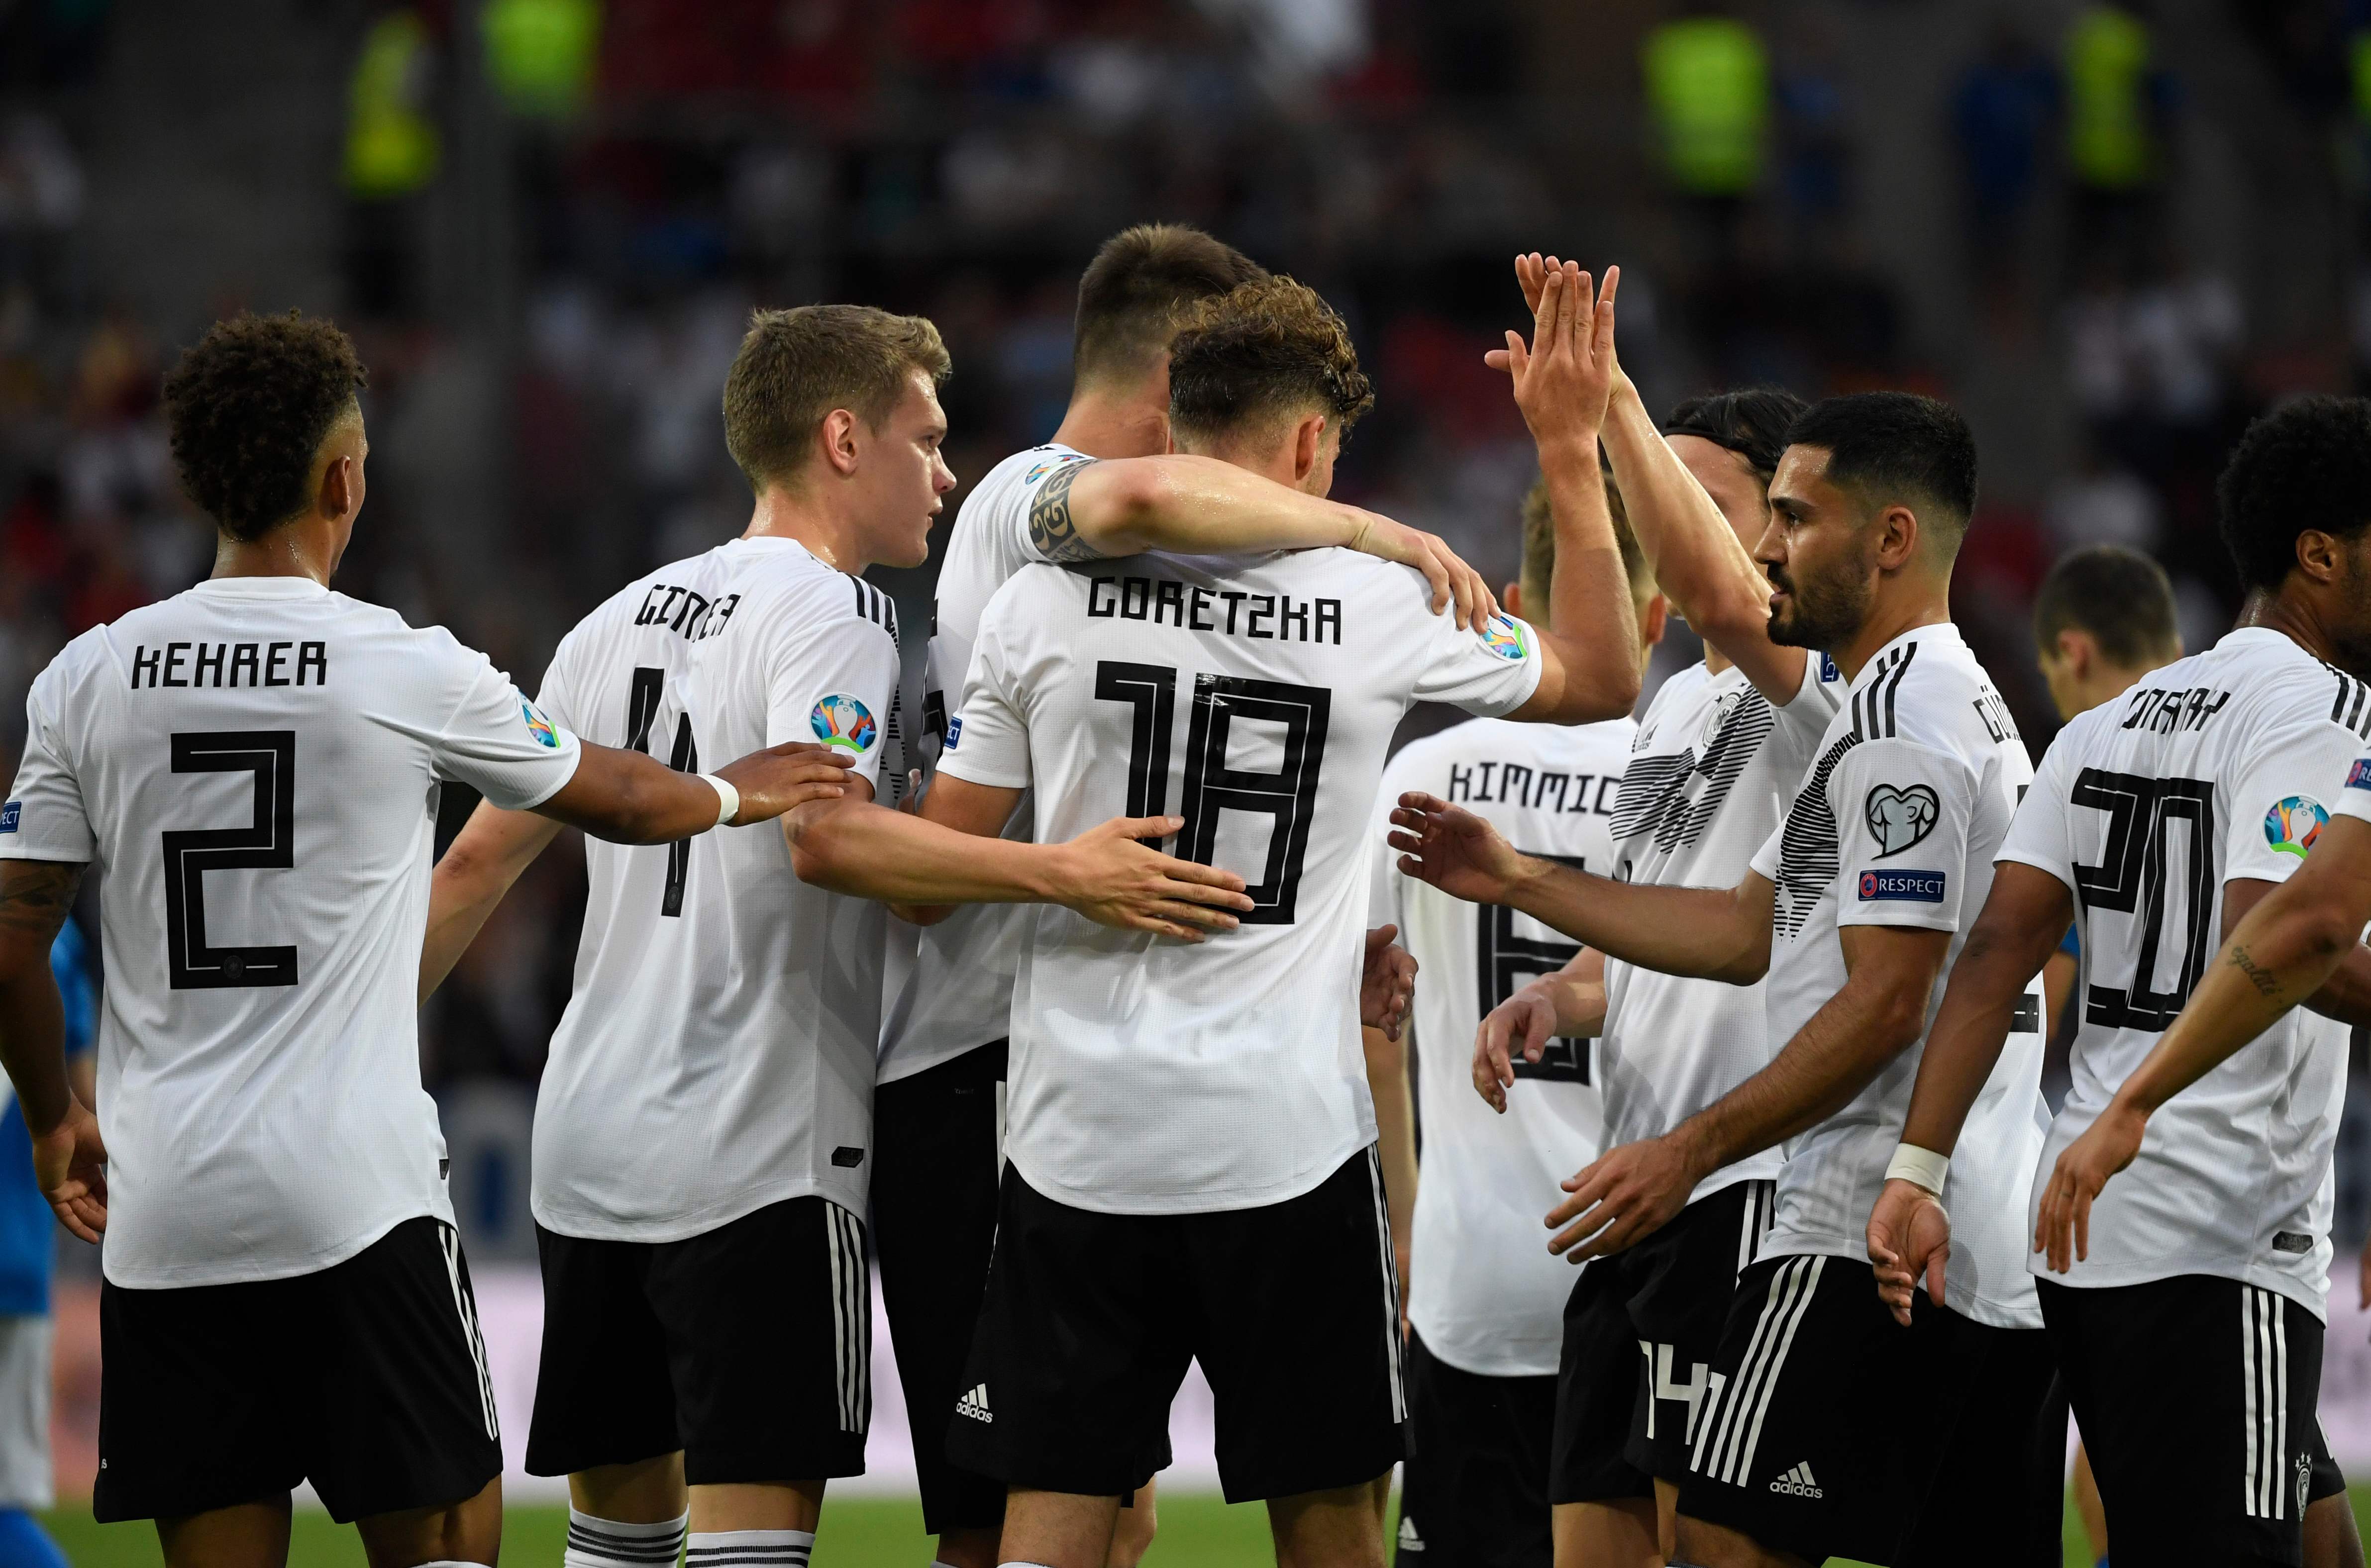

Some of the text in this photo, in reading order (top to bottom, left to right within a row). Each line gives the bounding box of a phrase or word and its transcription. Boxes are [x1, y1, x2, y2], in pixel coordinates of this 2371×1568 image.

[634, 584, 741, 643] GINER
[1087, 576, 1341, 645] GORETZKA
[131, 641, 327, 689] KEHRER
[624, 667, 697, 917] 4
[1095, 660, 1332, 924] 18
[1448, 762, 1622, 816] KIMMIC
[162, 730, 299, 989] 2
[1878, 878, 1944, 894] RESPECT
[2070, 767, 2214, 1033] 20
[956, 1402, 993, 1423] adidas
[1769, 1481, 1823, 1499] adidas
